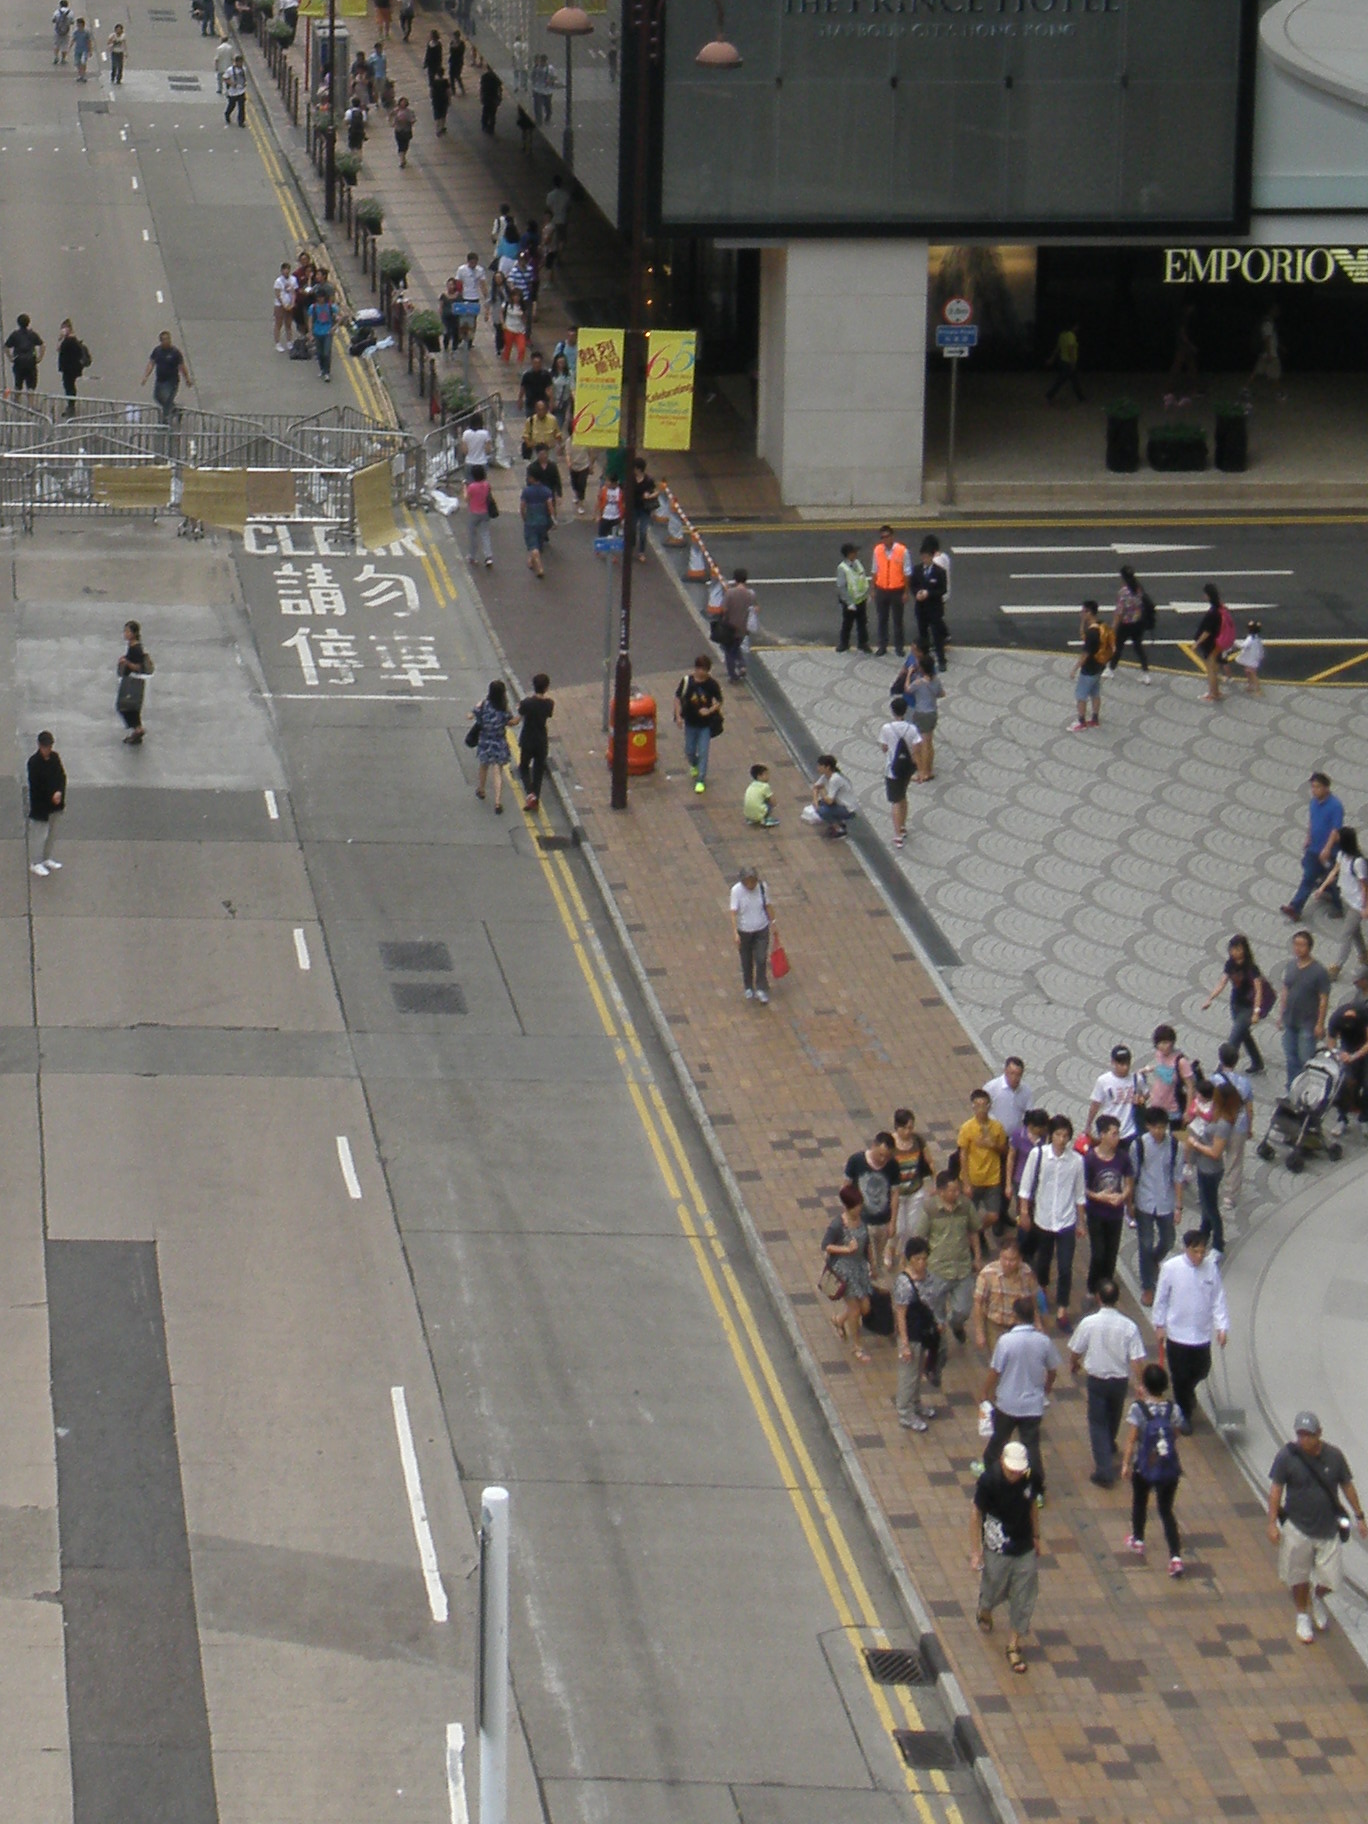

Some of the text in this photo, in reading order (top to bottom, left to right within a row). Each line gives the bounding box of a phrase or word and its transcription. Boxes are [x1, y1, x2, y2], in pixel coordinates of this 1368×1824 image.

[1163, 248, 1334, 283] EMPORIO
[646, 340, 695, 380] 65
[572, 395, 621, 433] 65
[273, 562, 421, 617] 請勿
[281, 627, 449, 687] 停車
